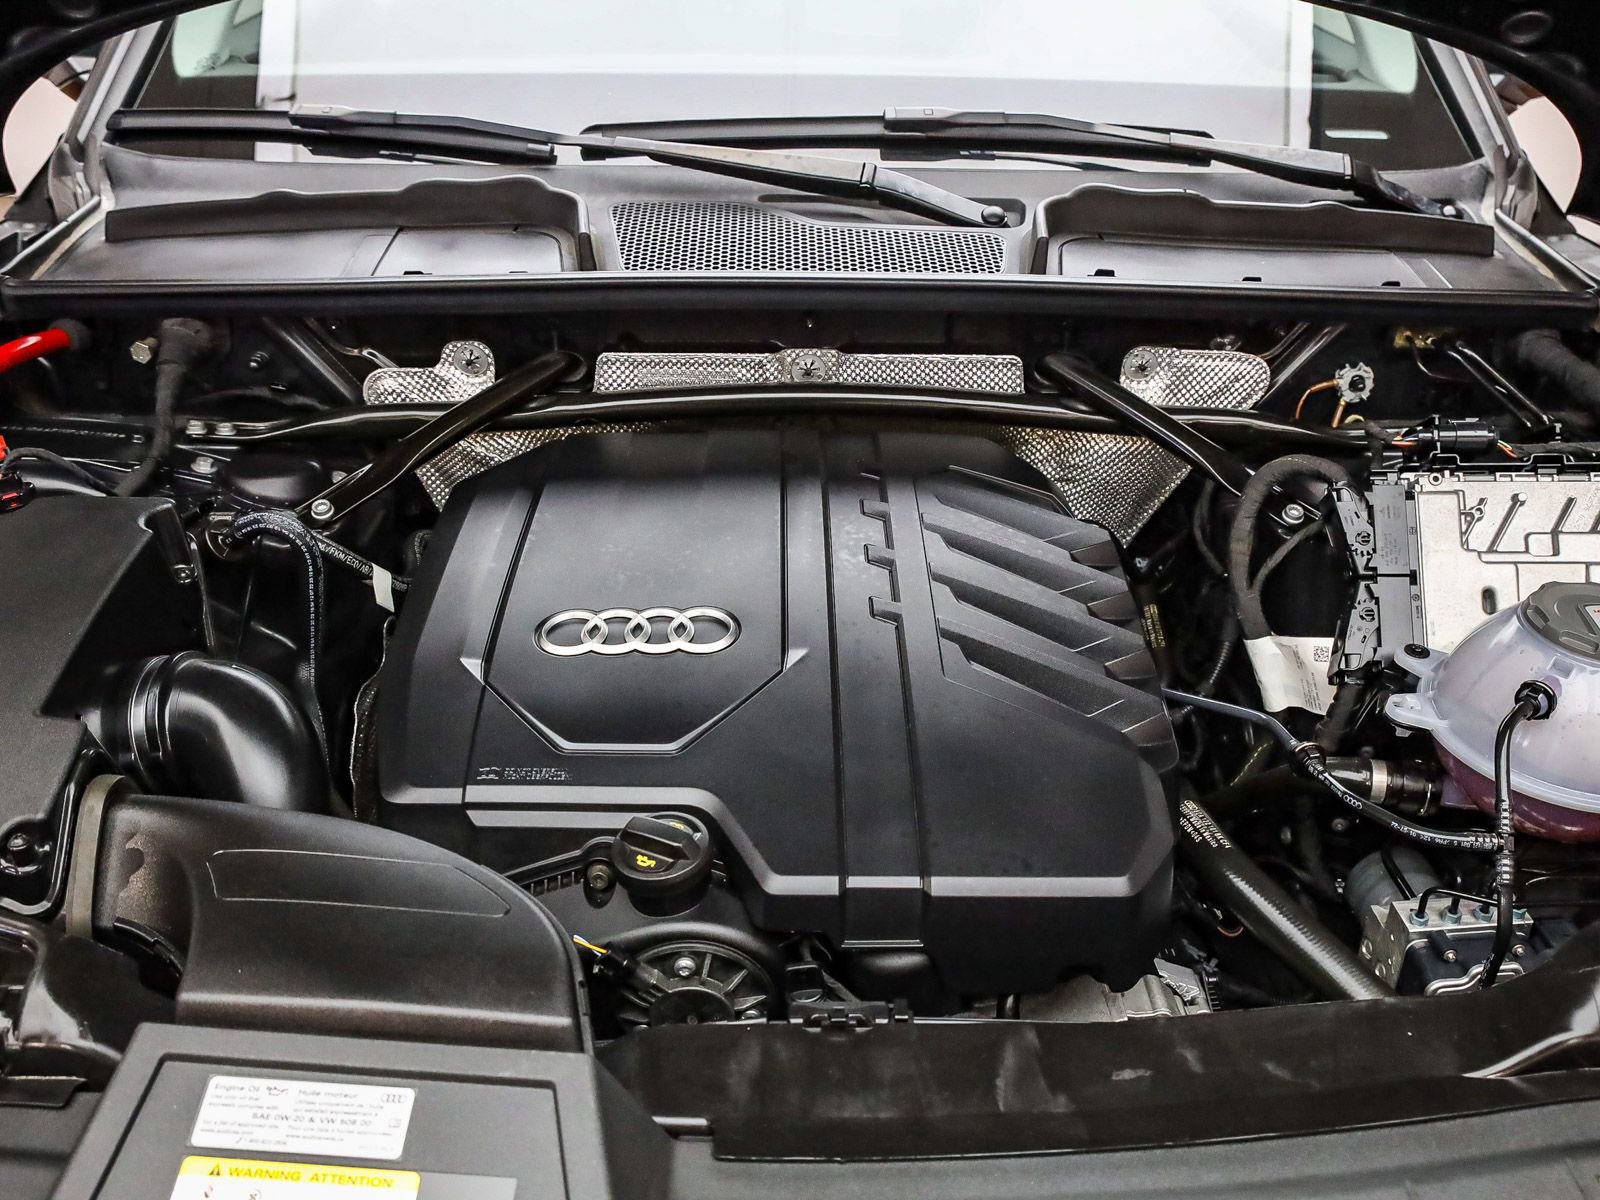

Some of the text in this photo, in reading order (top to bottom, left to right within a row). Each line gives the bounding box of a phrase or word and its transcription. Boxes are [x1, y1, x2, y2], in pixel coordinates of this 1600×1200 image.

[214, 1083, 245, 1094] Engine
[298, 1088, 359, 1098] Huile moteur
[252, 1112, 271, 1120] SAE
[320, 1116, 337, 1125] VW
[228, 1166, 395, 1188] WARNING ATTENTION
